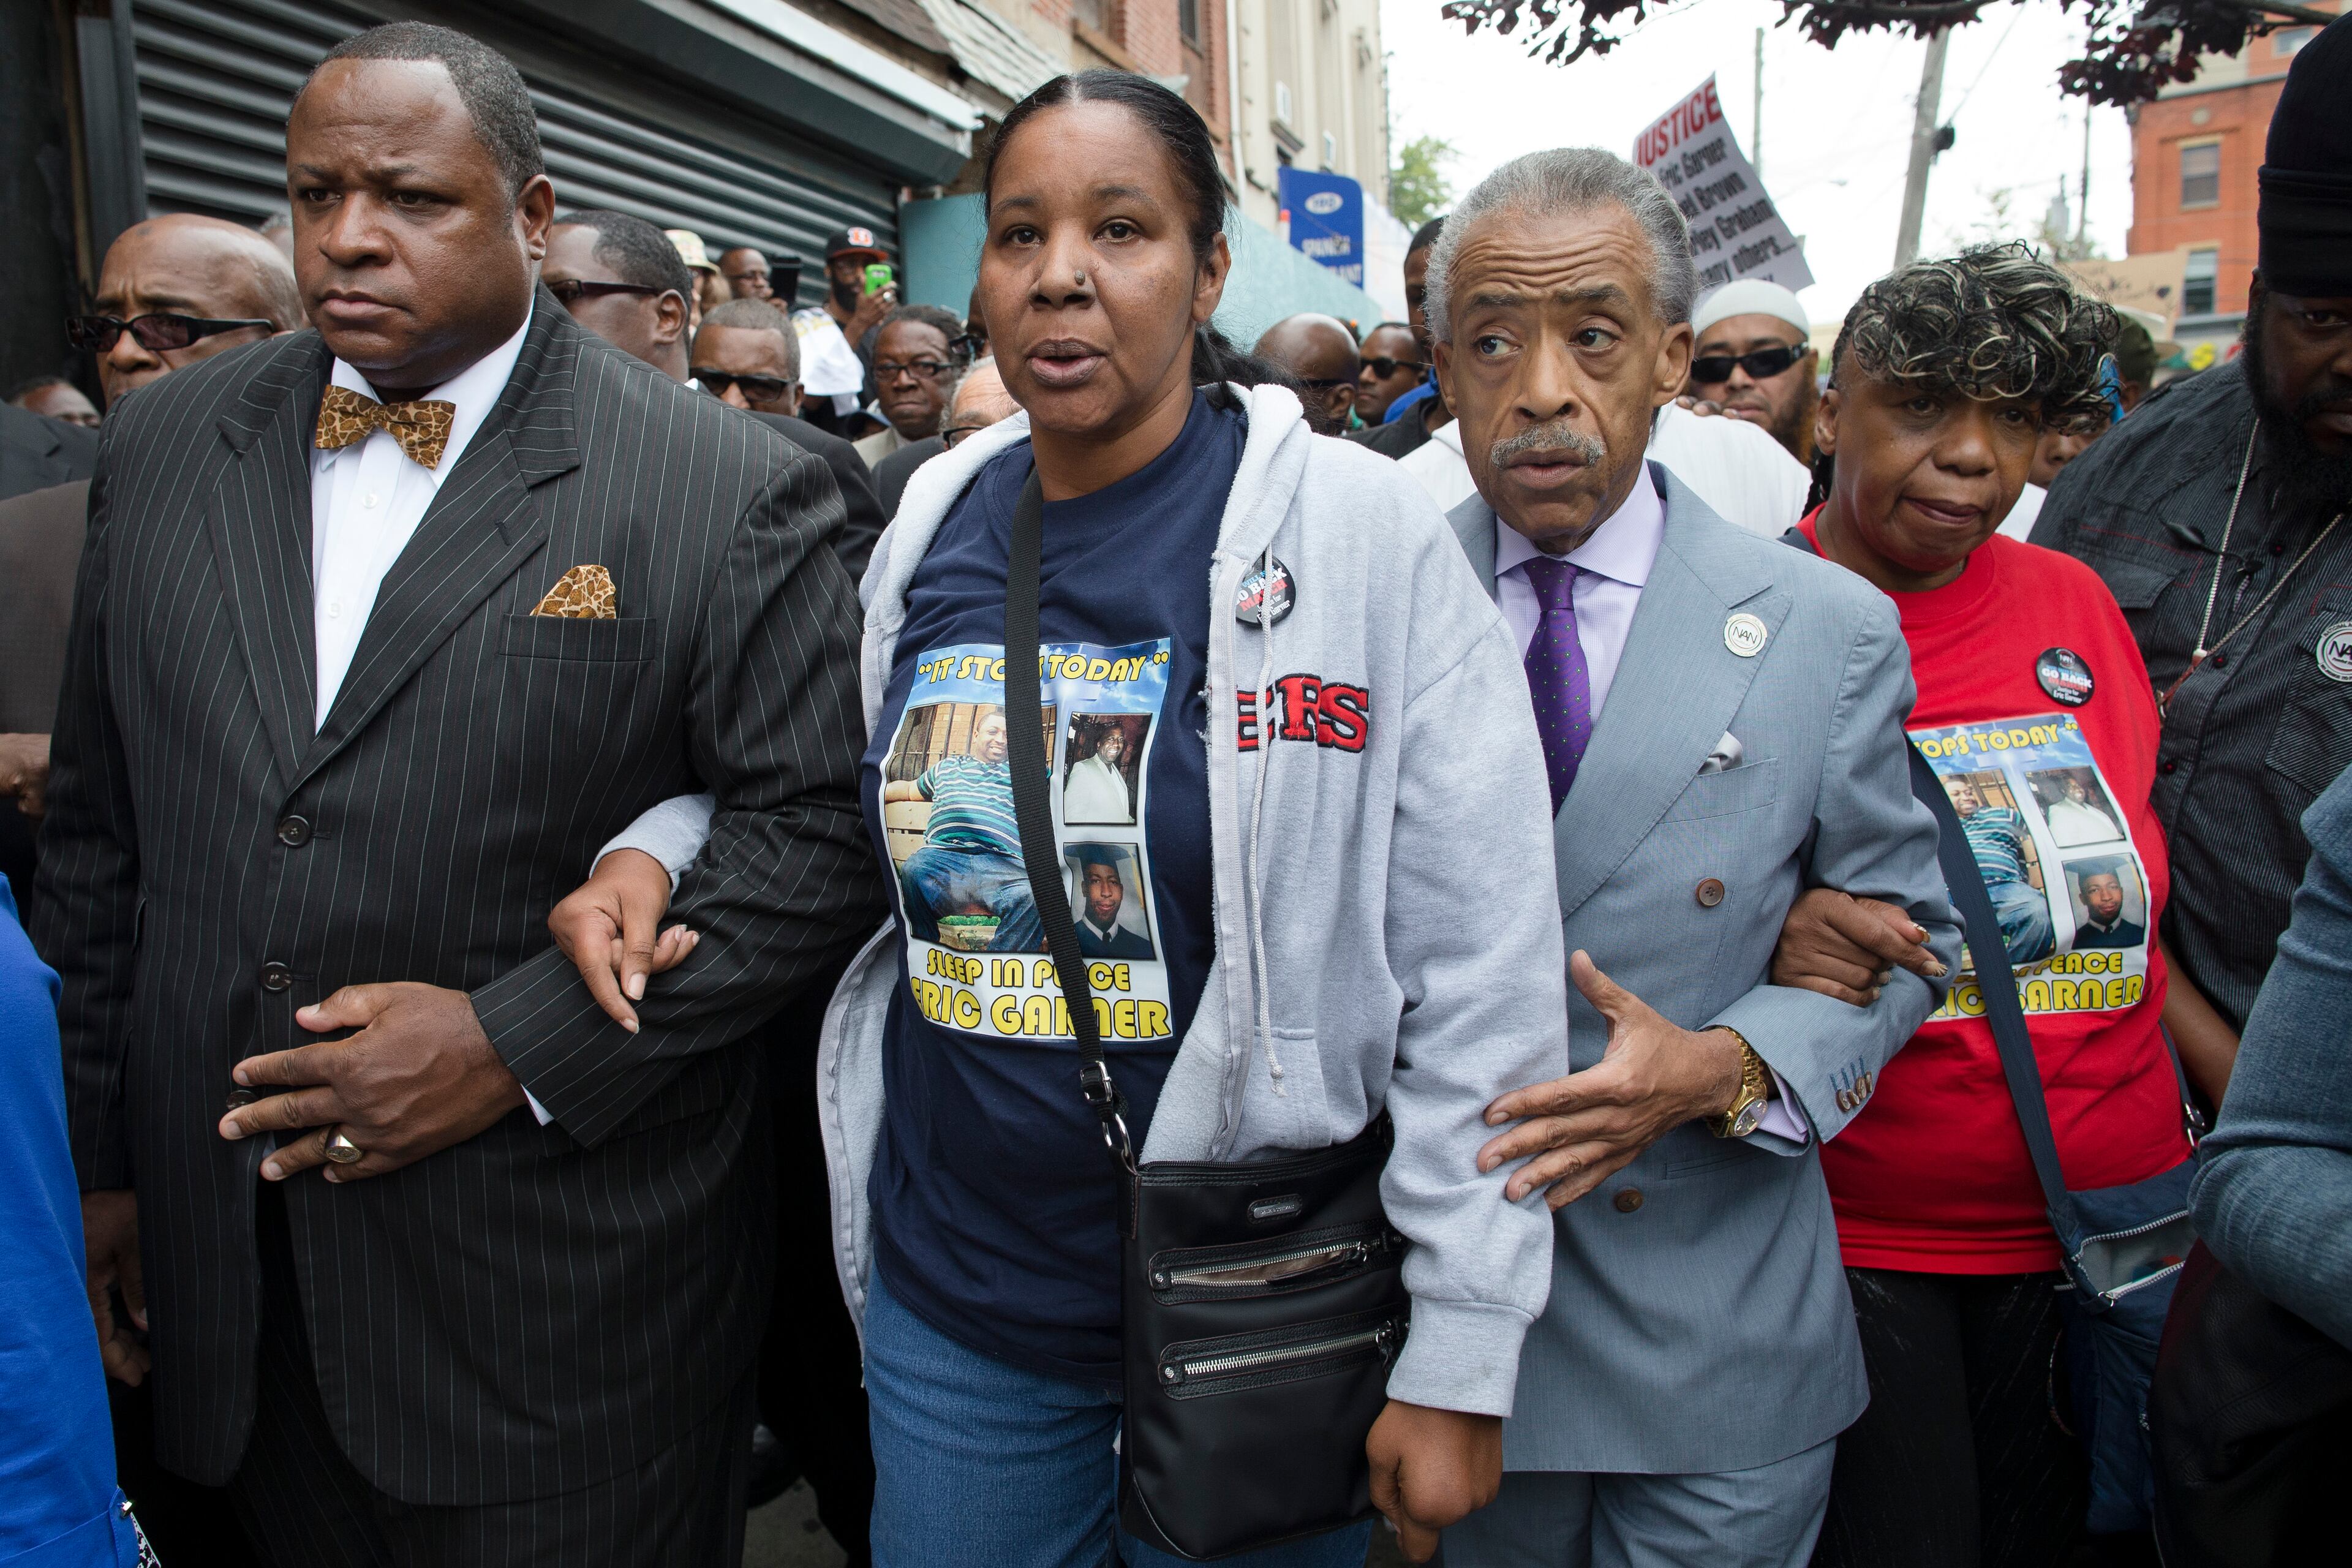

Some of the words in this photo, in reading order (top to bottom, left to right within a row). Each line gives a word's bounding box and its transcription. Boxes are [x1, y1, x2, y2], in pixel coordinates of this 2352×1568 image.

[1235, 590, 1249, 605] O
[1238, 578, 1288, 612] MACH
[1732, 626, 1758, 644] NAN
[956, 655, 1044, 682] STO
[1913, 734, 1970, 758] OPS
[927, 948, 983, 986] SLEEP
[991, 959, 1024, 987] IN
[1033, 959, 1131, 992] PCE
[2032, 951, 2123, 975] PEACE
[911, 976, 982, 1030] ERIC
